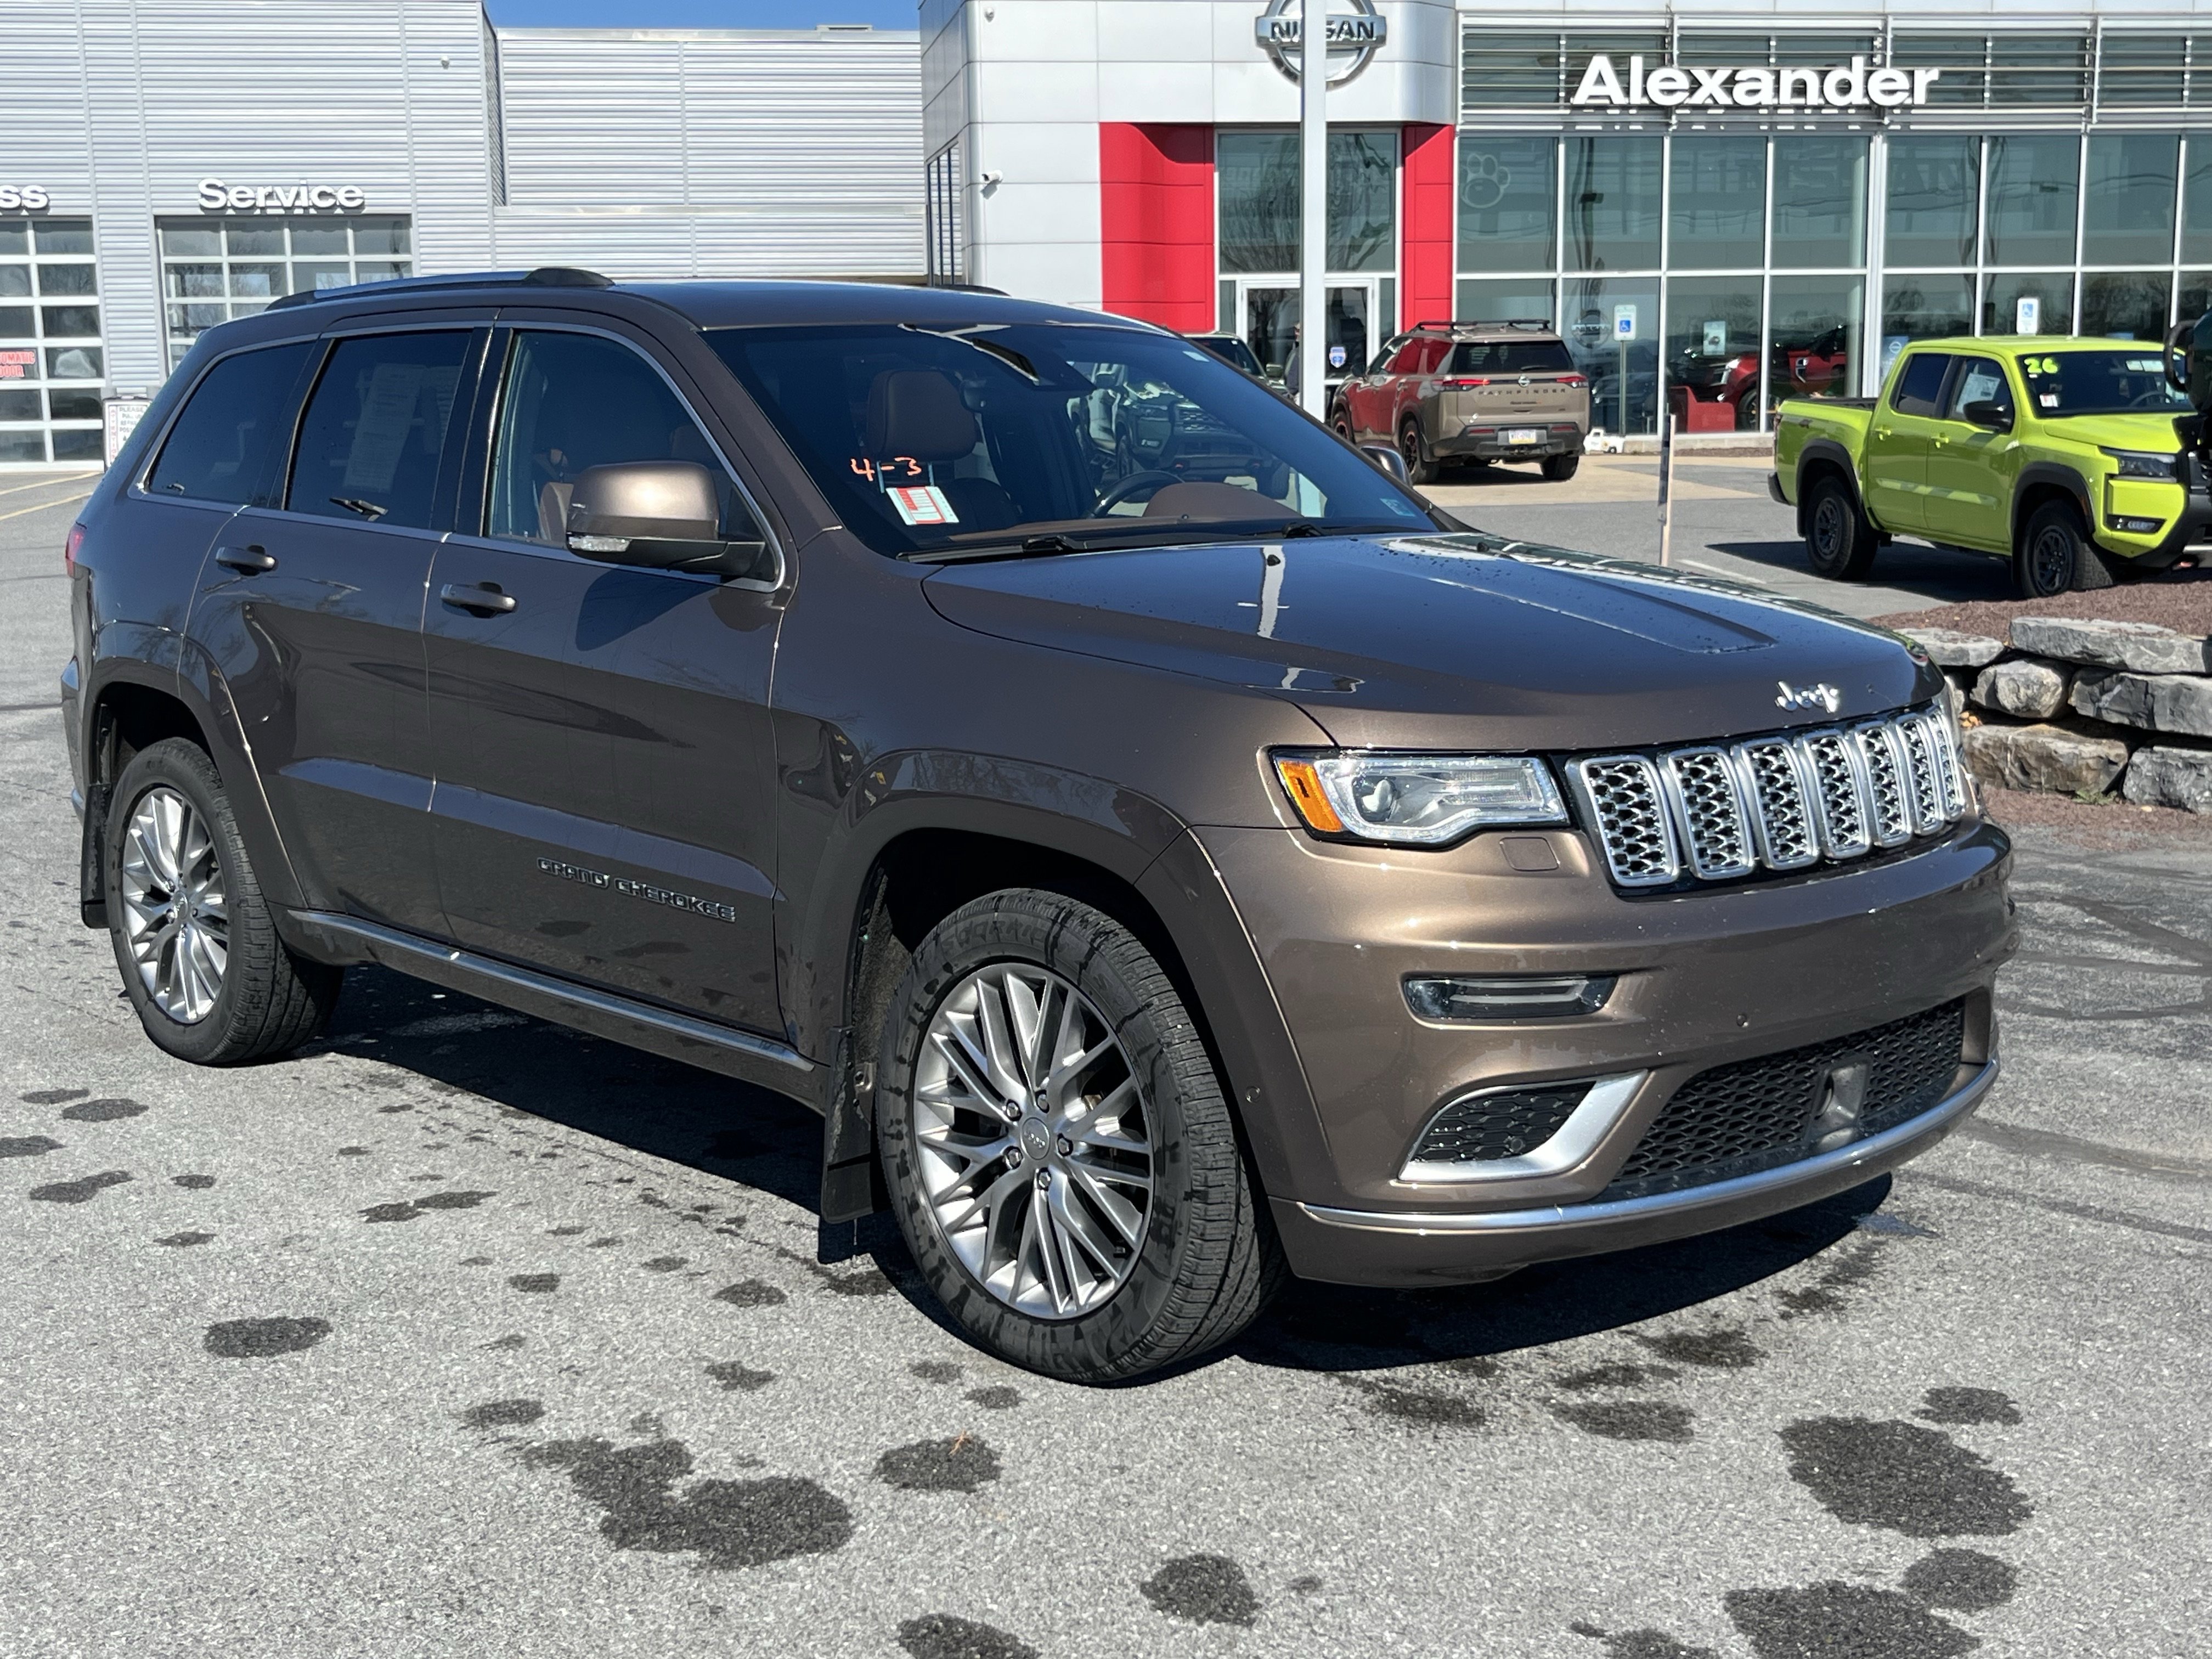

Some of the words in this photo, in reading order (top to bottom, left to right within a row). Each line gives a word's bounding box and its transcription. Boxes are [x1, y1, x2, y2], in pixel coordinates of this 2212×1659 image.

[1271, 20, 1375, 42] NISAN
[1572, 55, 1939, 106] Alexander
[198, 178, 364, 208] Service
[2023, 358, 2058, 374] 26
[850, 456, 922, 482] 4-3
[1775, 681, 1838, 713] Jeep
[537, 857, 610, 889] GRAND
[614, 878, 736, 923] CHEROKEE
